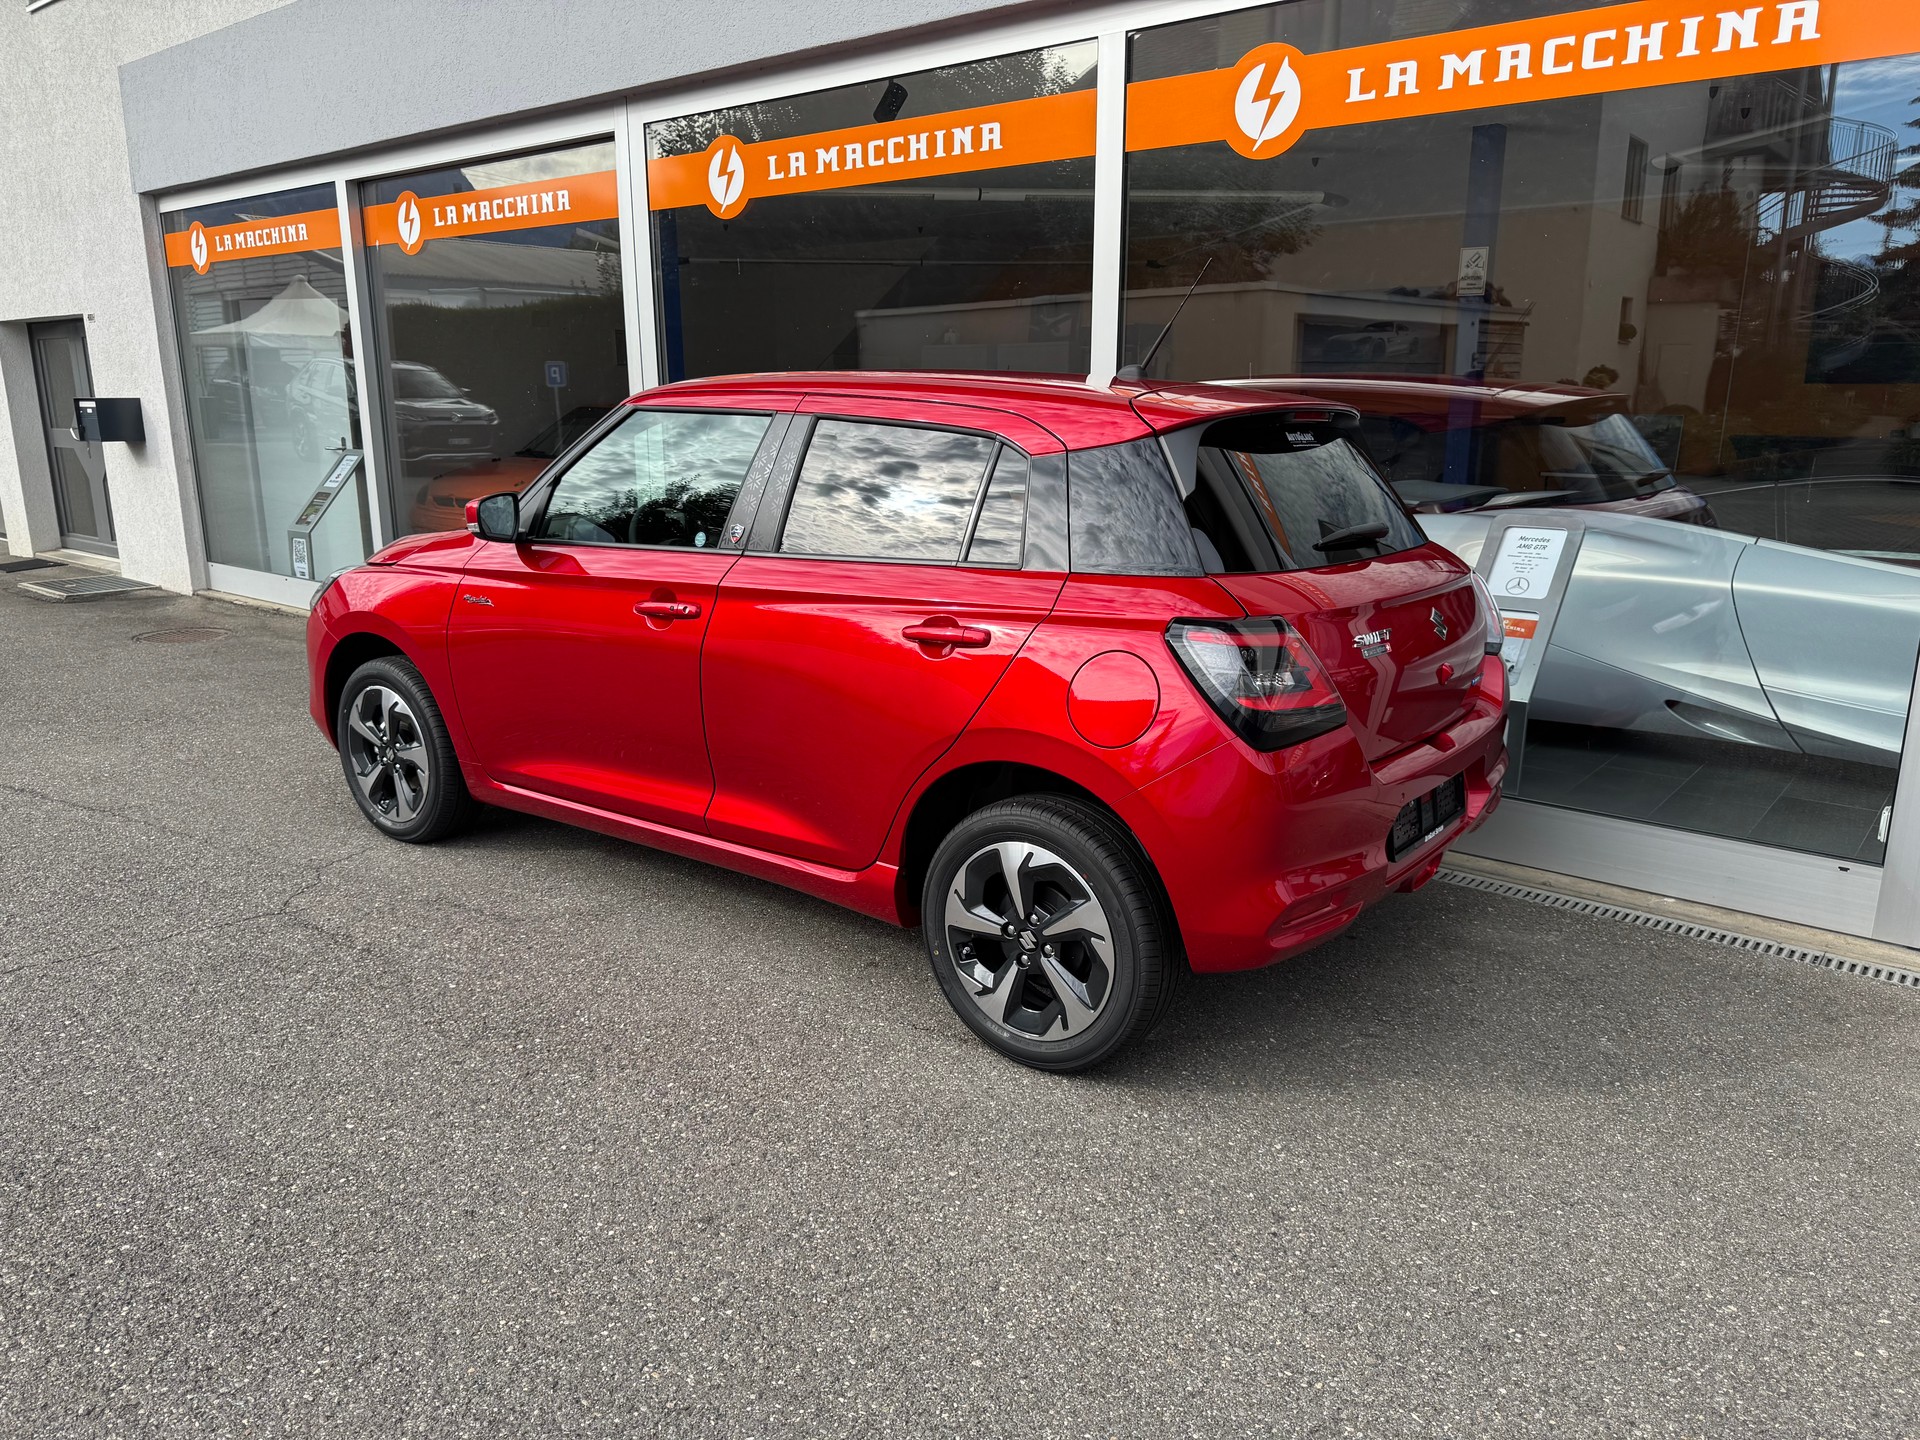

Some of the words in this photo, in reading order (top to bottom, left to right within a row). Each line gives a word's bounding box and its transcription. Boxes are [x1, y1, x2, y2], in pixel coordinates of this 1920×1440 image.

[1345, 60, 1420, 103] LA
[1437, 0, 1822, 90] MACCHINA
[767, 151, 807, 180] LA
[815, 122, 1003, 174] MACCHINA
[433, 205, 459, 227] LA
[461, 189, 571, 223] MACCHINA
[215, 234, 233, 254] LA
[234, 223, 309, 251] MACCHINA
[1518, 535, 1551, 543] Mercedes
[1352, 628, 1392, 648] SWIFT
